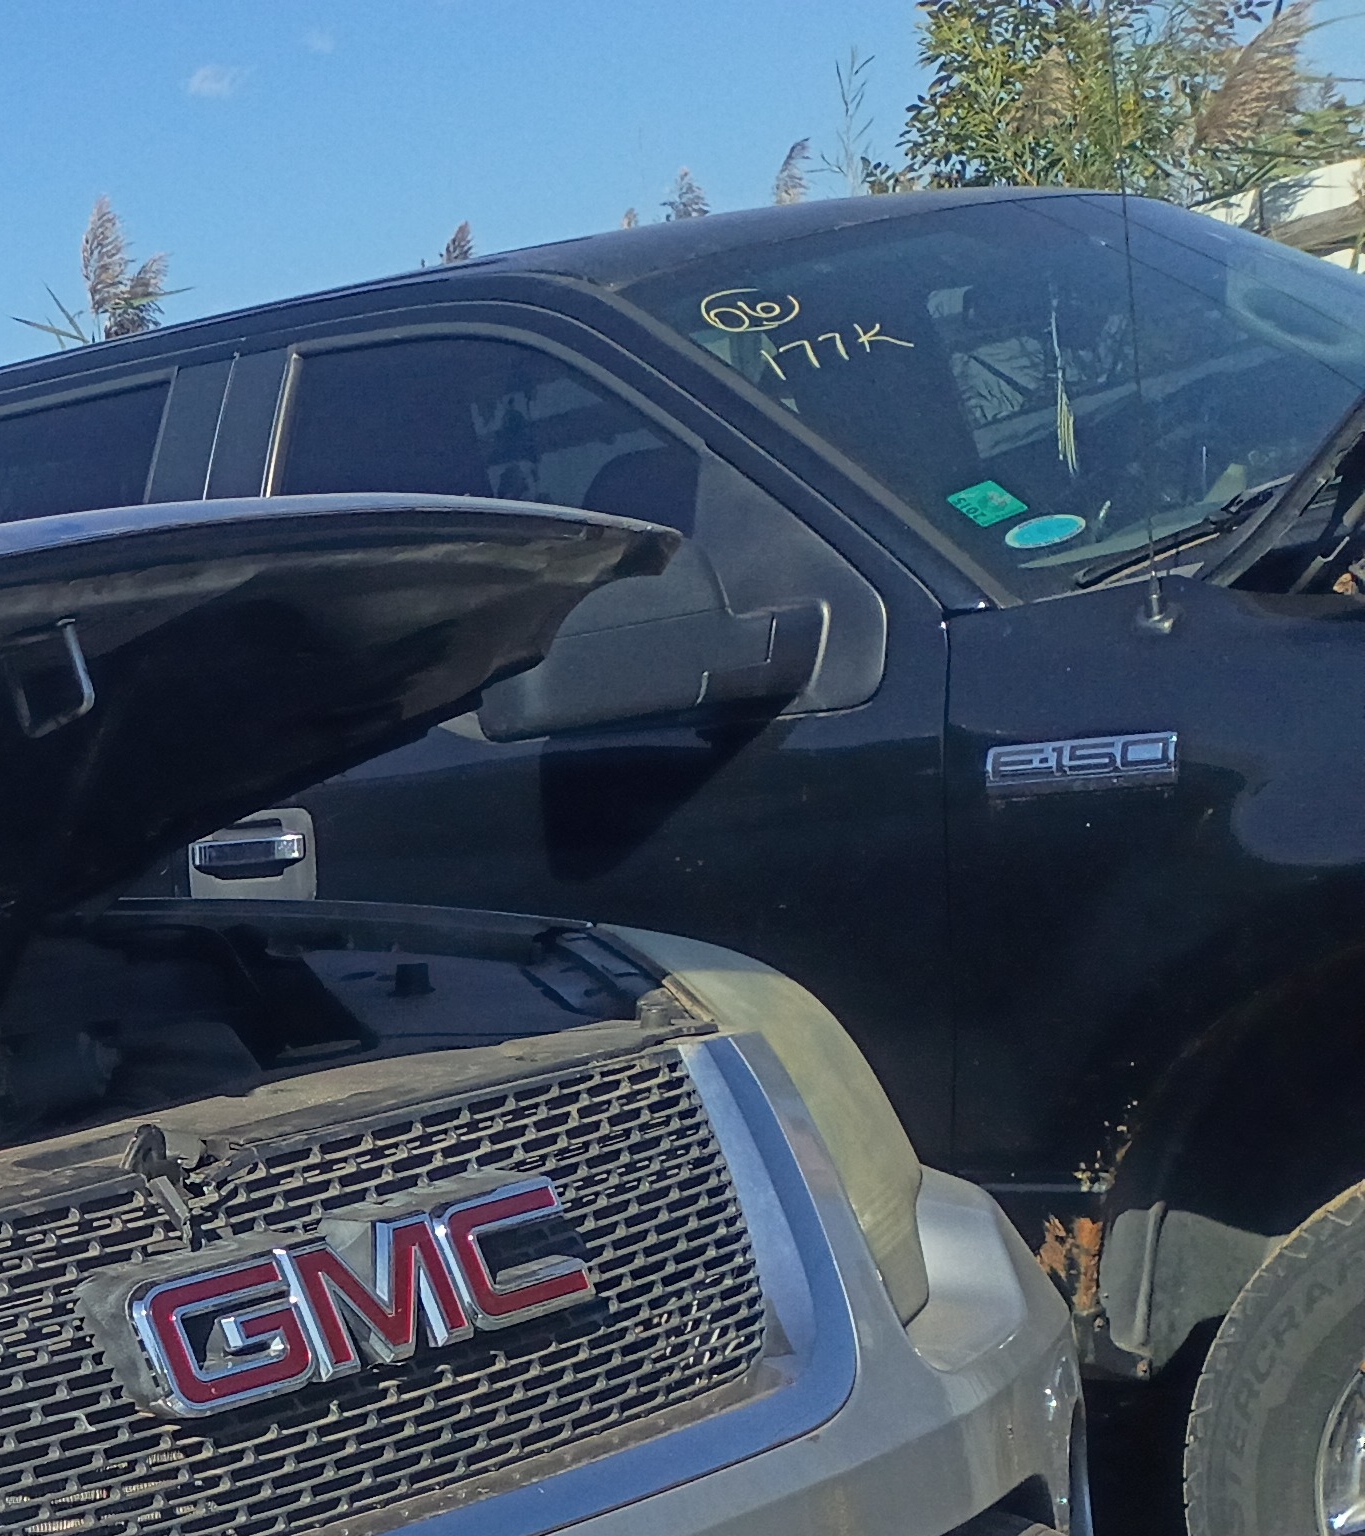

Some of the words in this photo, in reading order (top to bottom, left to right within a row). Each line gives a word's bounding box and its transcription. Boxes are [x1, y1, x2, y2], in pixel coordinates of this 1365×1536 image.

[760, 322, 915, 381] 177K
[955, 496, 988, 520] 2015
[133, 1175, 597, 1418] GMC
